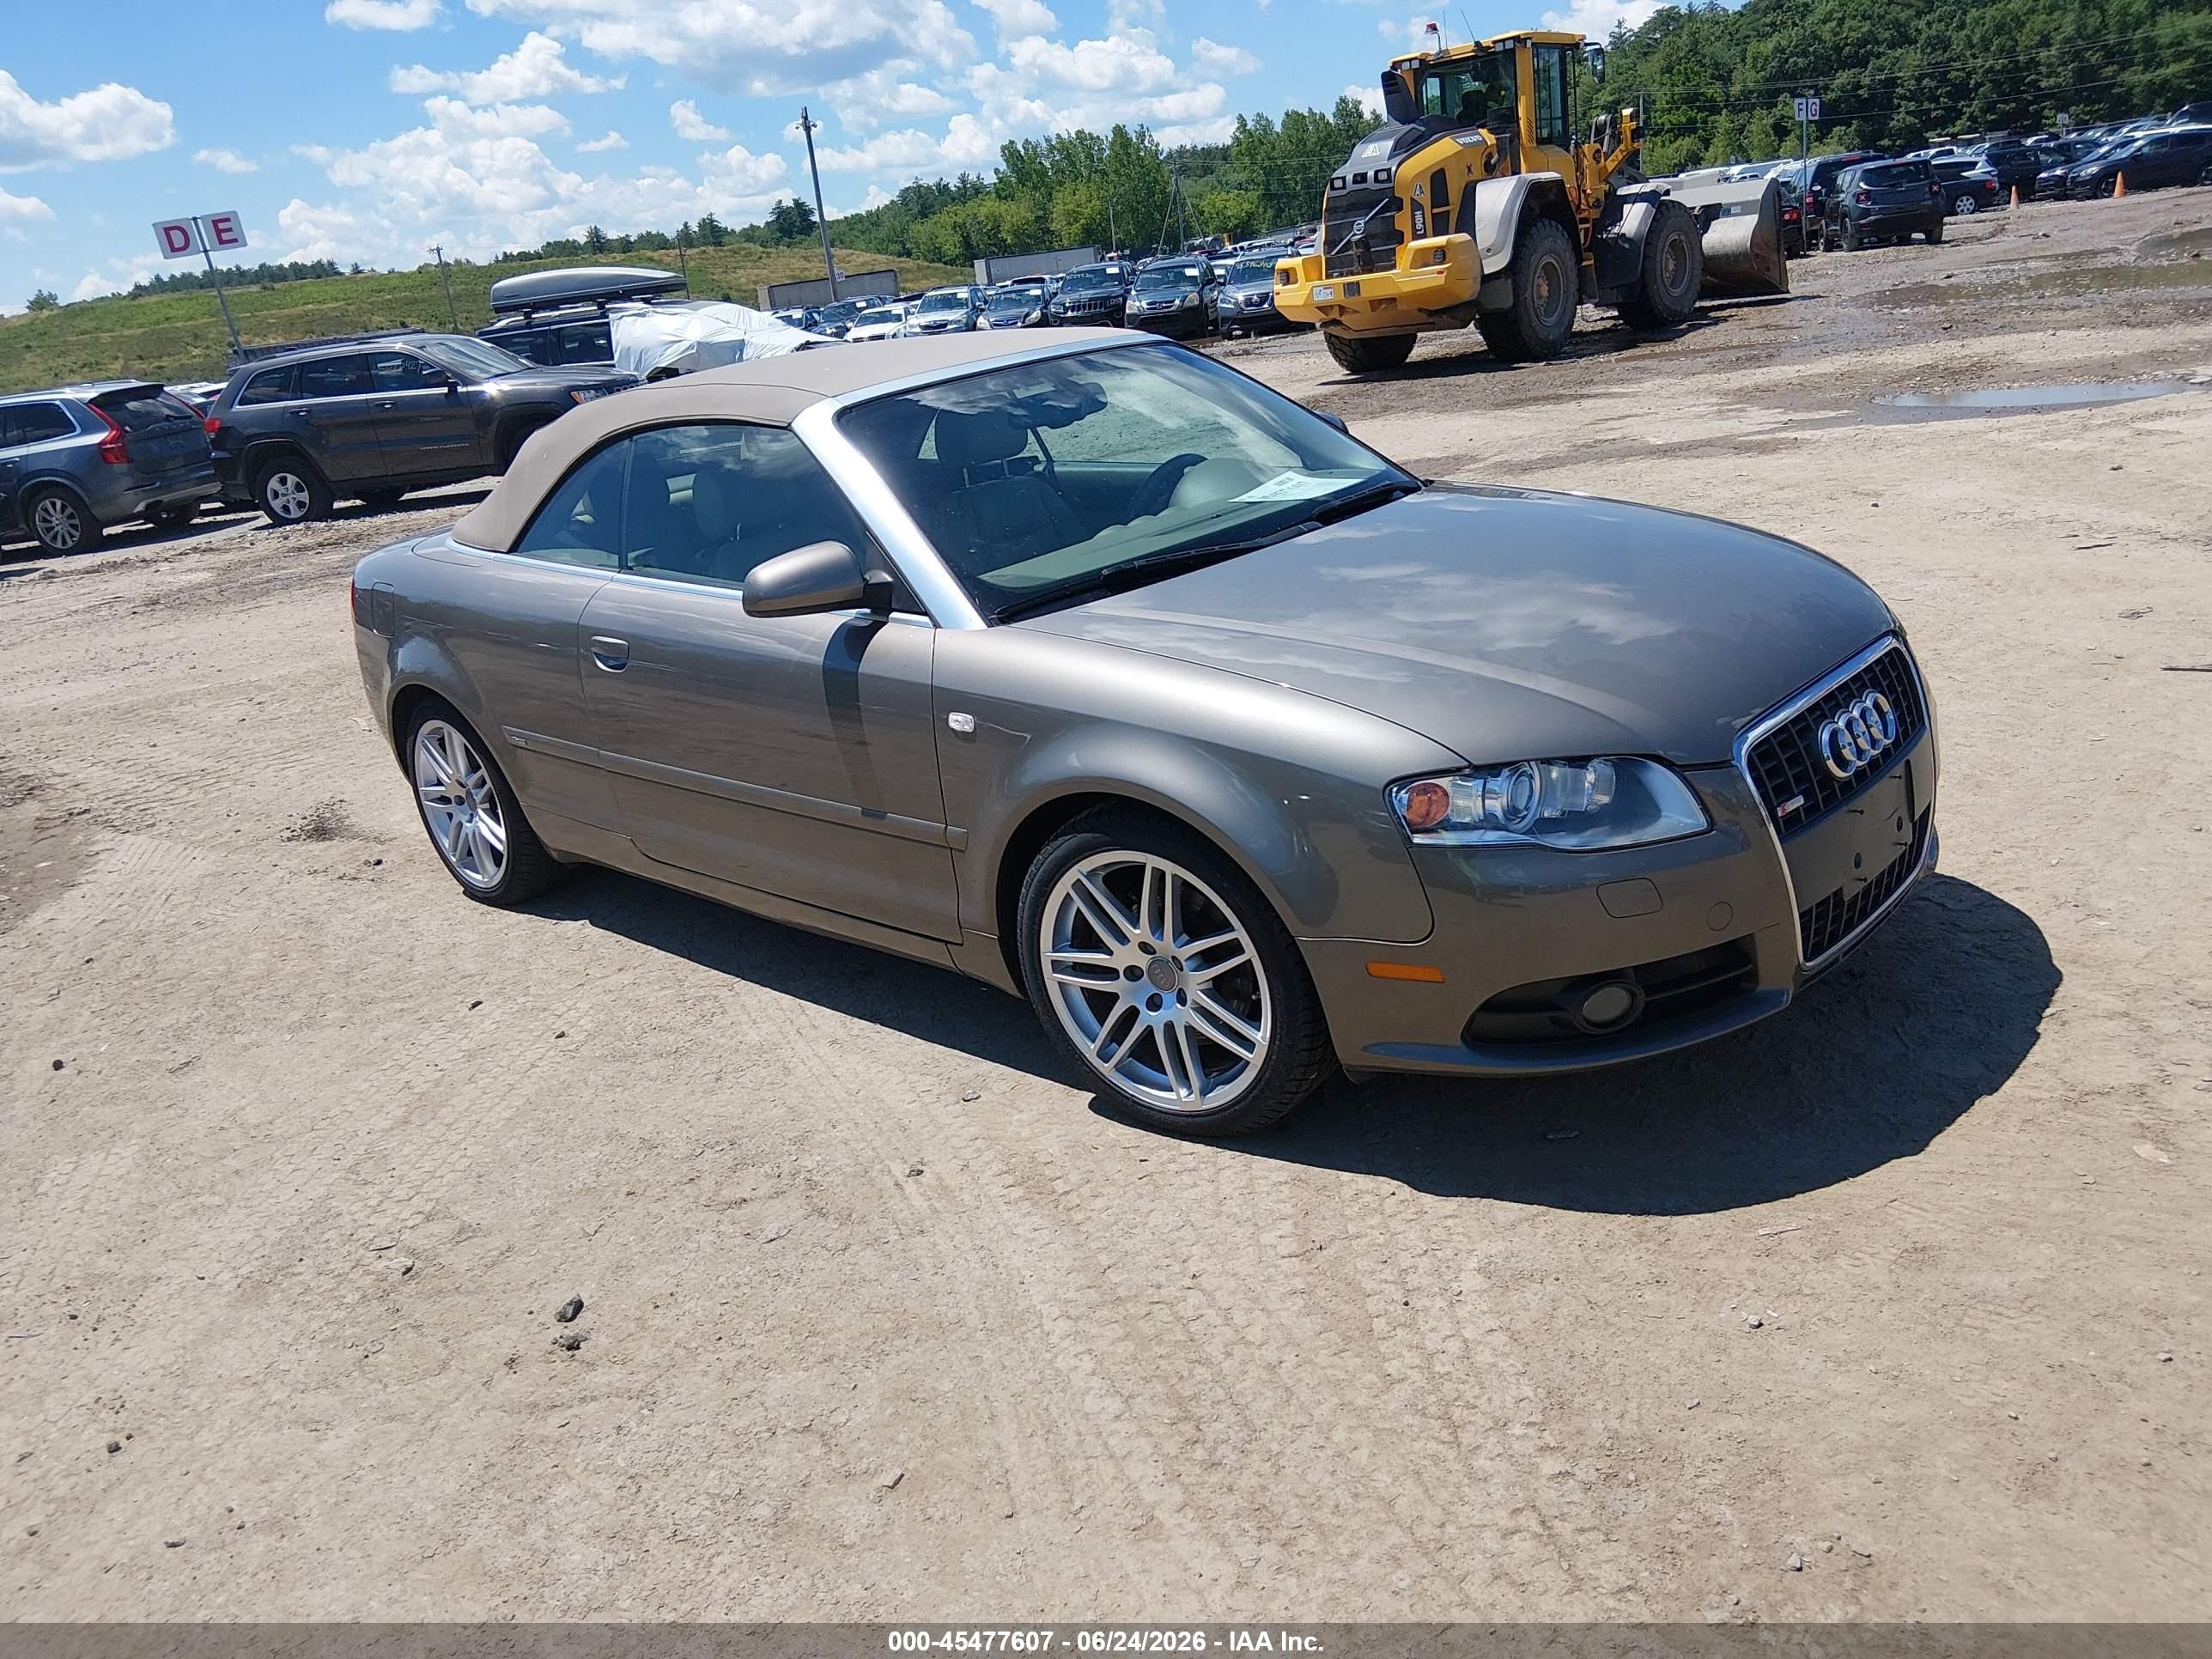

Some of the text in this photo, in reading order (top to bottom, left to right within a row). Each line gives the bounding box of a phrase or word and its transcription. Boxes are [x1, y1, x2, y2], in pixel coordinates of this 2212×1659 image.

[1797, 102, 1804, 118] F
[1809, 101, 1818, 118] G
[1454, 134, 1483, 144] VOLVO
[1414, 210, 1425, 234] L90H
[162, 225, 191, 253] D
[211, 216, 239, 246] E
[836, 271, 845, 280] 30
